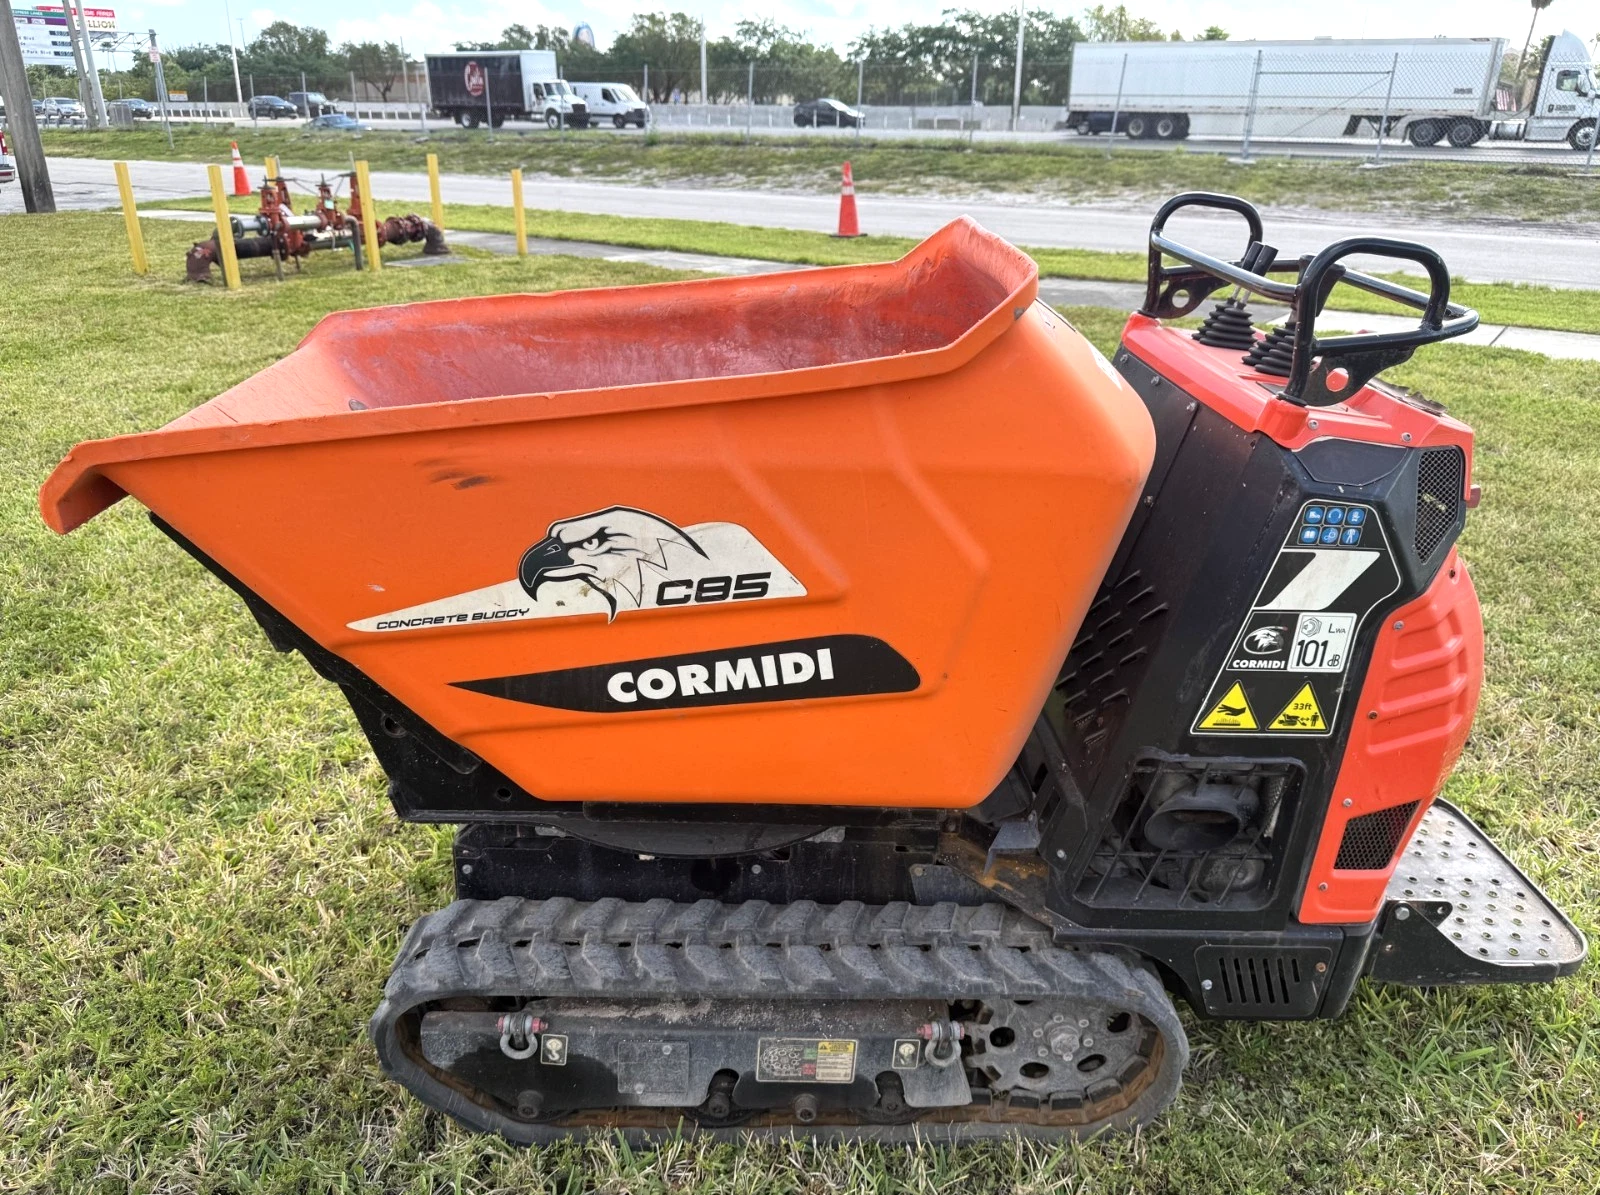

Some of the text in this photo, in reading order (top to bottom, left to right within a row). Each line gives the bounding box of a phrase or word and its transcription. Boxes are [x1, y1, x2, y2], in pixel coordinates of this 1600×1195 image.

[656, 572, 772, 606] C85
[376, 607, 530, 630] CONCRETE BUGGY
[1232, 659, 1286, 669] CORMIDI
[1296, 639, 1341, 667] 101 dB
[607, 647, 835, 704] CORMIDI
[1293, 702, 1313, 711] 33ft
